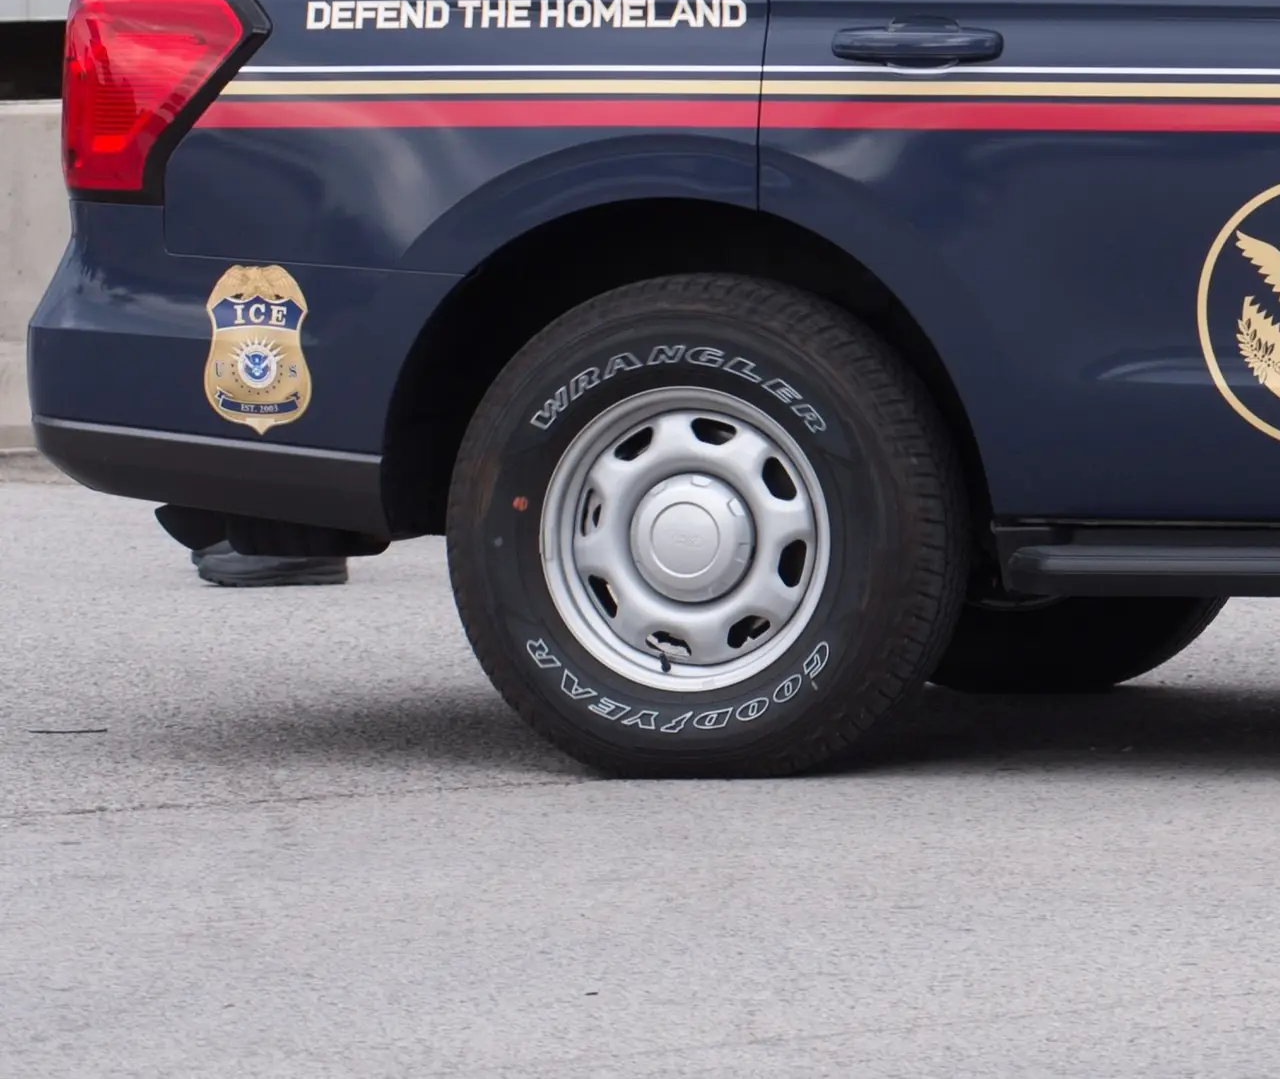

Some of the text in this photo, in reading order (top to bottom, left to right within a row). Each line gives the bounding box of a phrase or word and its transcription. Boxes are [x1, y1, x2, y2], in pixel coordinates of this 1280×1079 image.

[306, 0, 450, 30] DEFEND
[233, 303, 287, 326] ICE
[530, 344, 828, 434] WRANGLER
[526, 638, 830, 733] GOODYEAR
